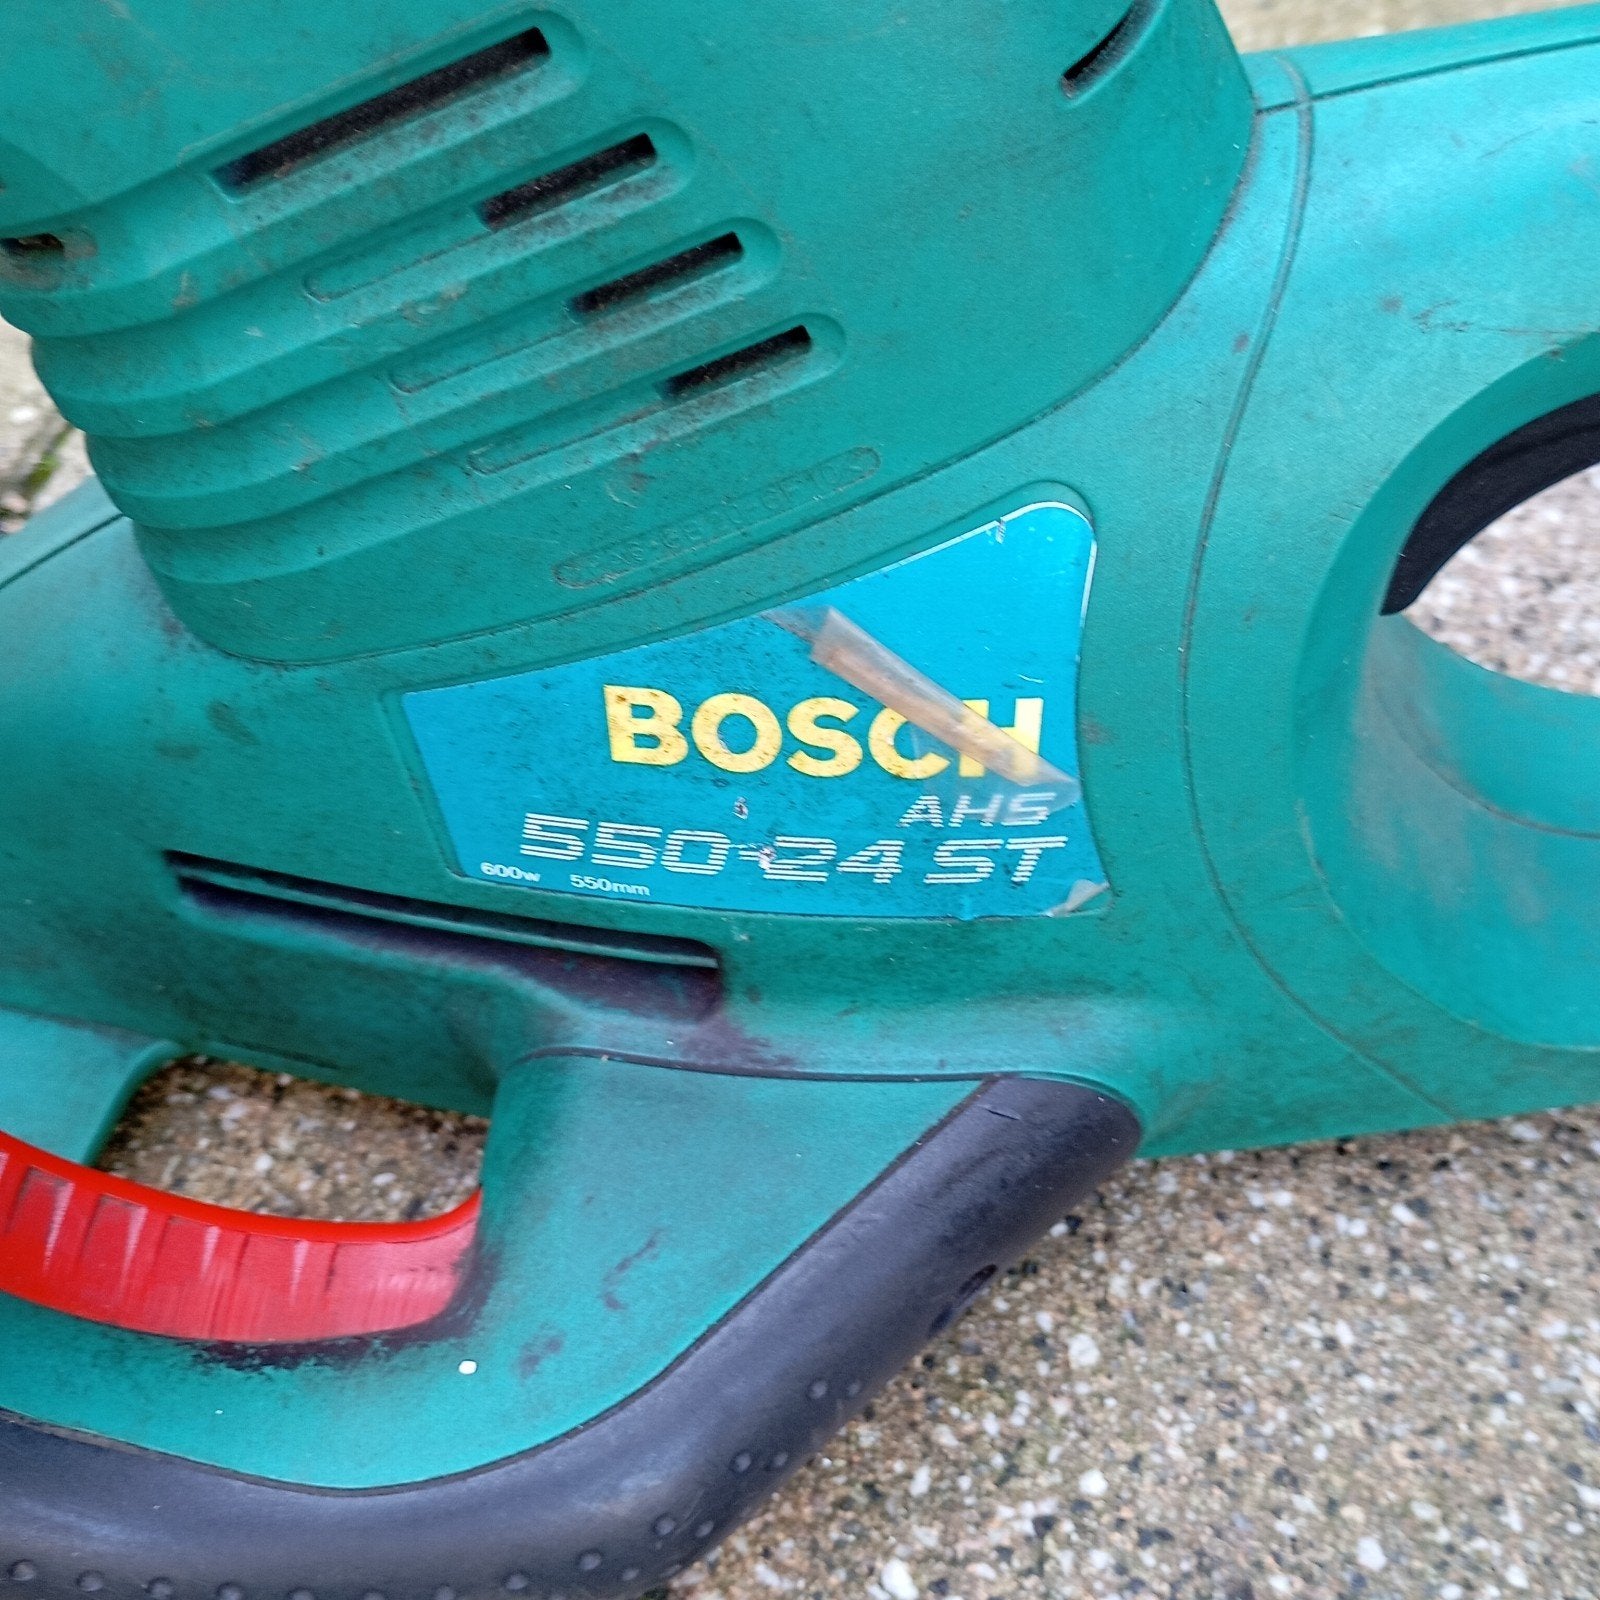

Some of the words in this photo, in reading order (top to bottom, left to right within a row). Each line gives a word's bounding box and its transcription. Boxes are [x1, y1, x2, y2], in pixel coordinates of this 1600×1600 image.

[603, 684, 1044, 780] BOSCH
[897, 792, 1057, 828] AHS
[520, 812, 906, 885] 550-24
[923, 835, 1069, 884] ST
[569, 874, 651, 896] 550mm
